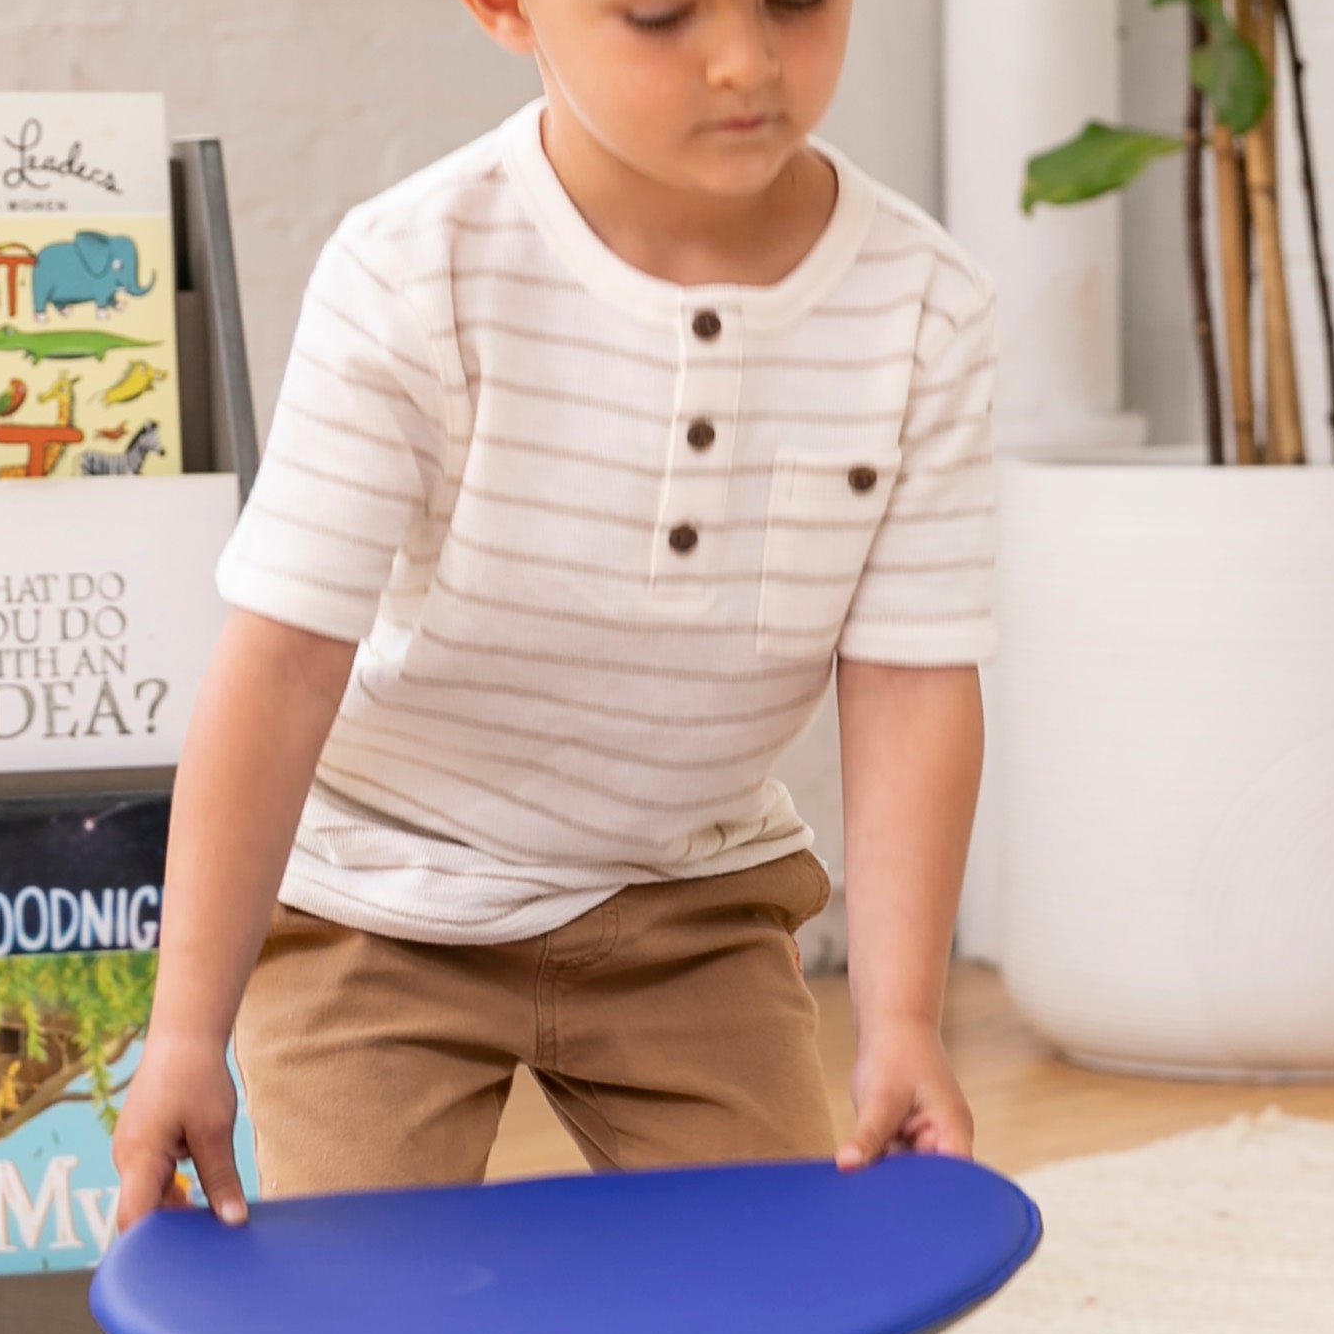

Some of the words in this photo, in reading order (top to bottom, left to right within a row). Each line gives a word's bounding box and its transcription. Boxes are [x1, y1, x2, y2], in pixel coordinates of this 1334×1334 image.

[67, 571, 126, 602] DO
[58, 605, 128, 641] DO
[73, 644, 128, 676] AN
